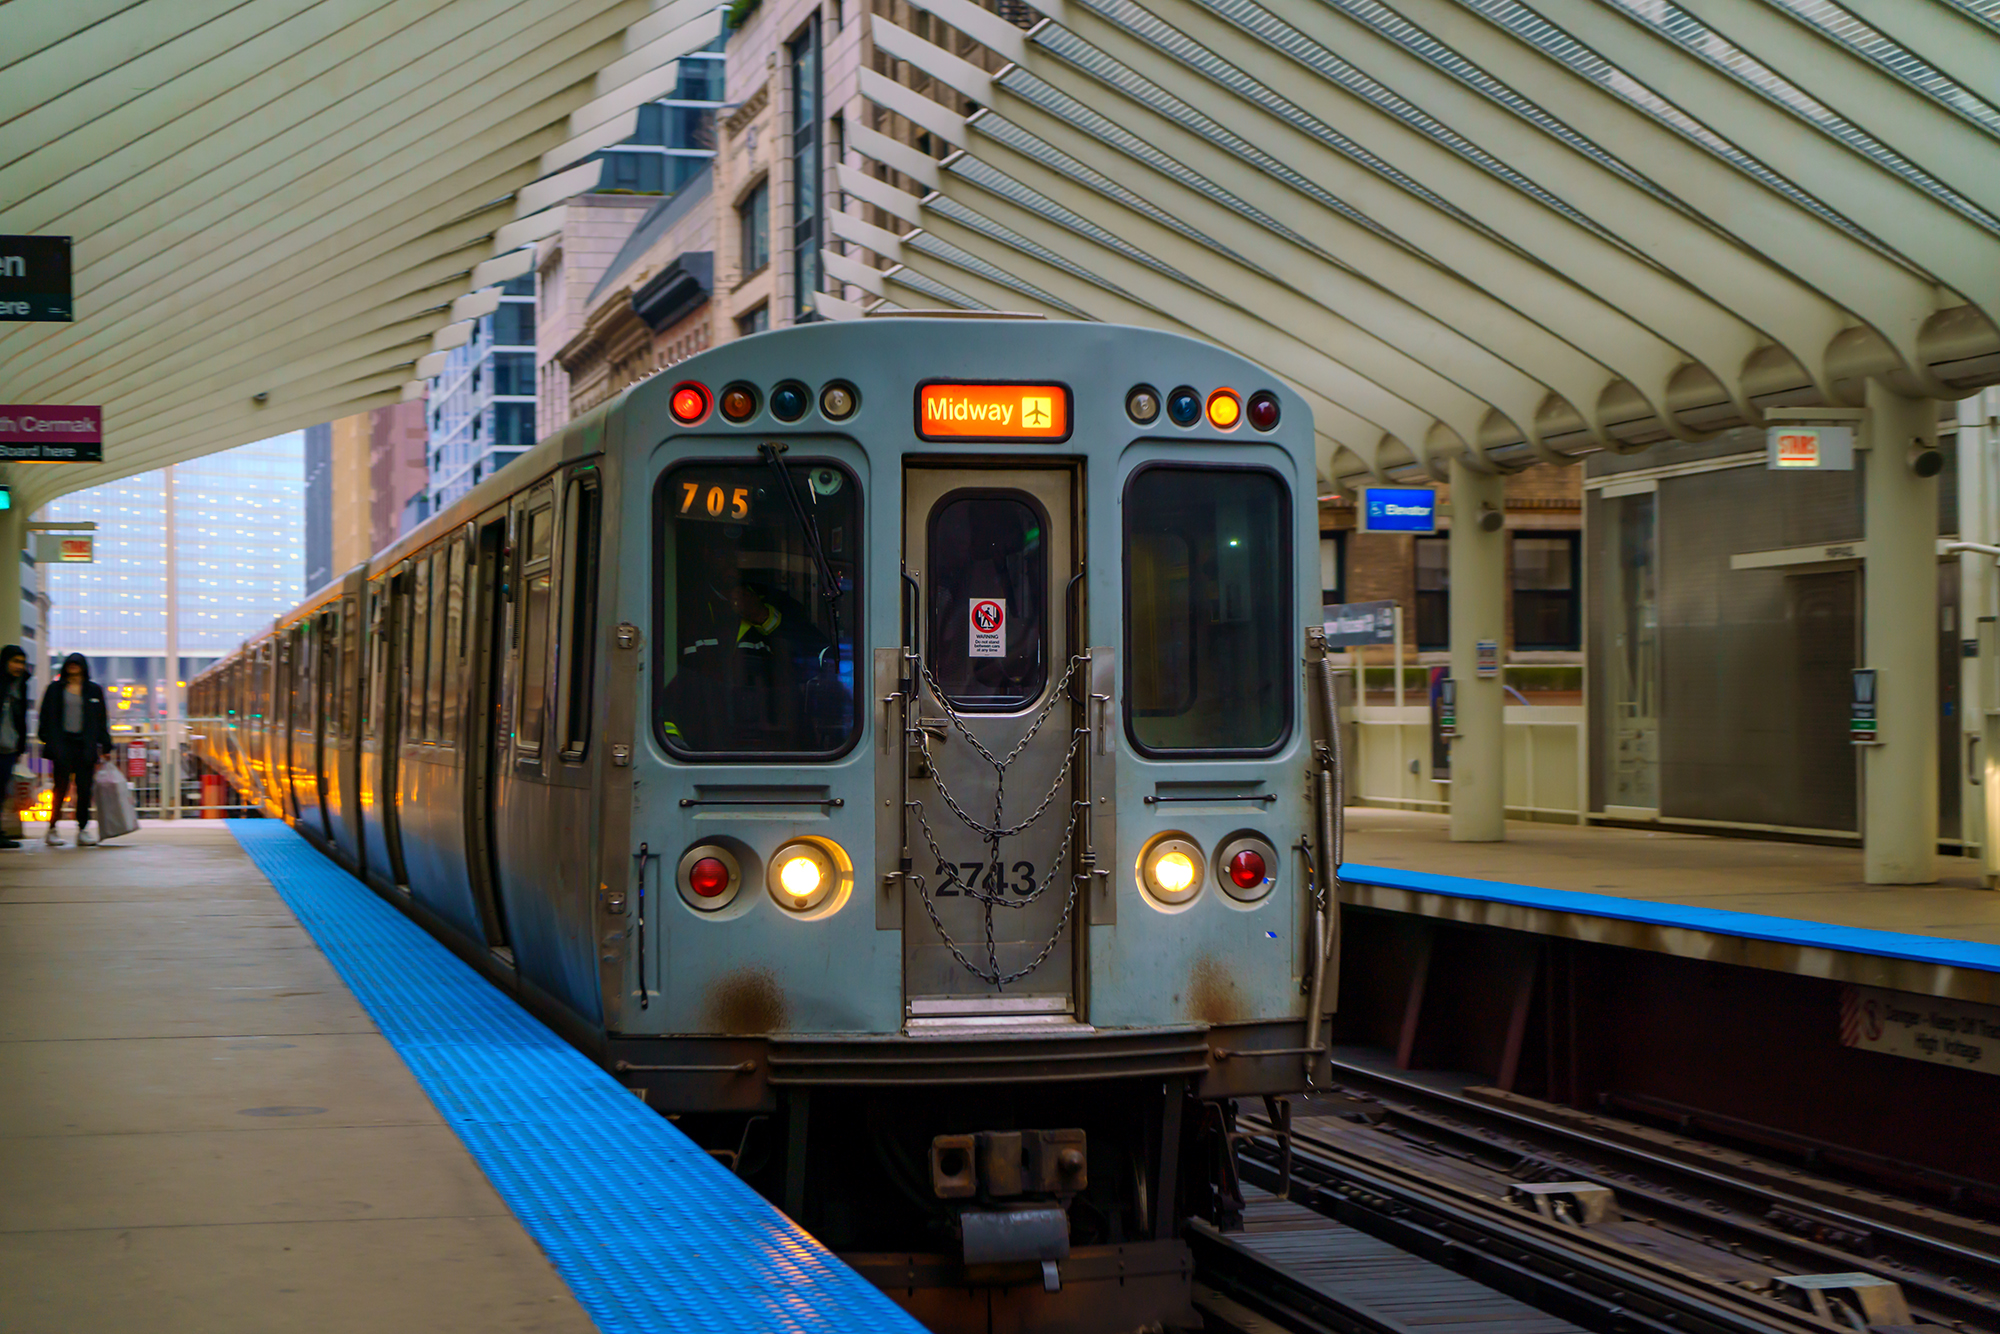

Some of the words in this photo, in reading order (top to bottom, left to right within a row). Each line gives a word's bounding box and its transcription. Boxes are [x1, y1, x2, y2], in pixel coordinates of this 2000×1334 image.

[0, 255, 26, 277] n
[927, 397, 1014, 426] Midway
[681, 482, 748, 519] 705
[934, 861, 1037, 897] 2743
